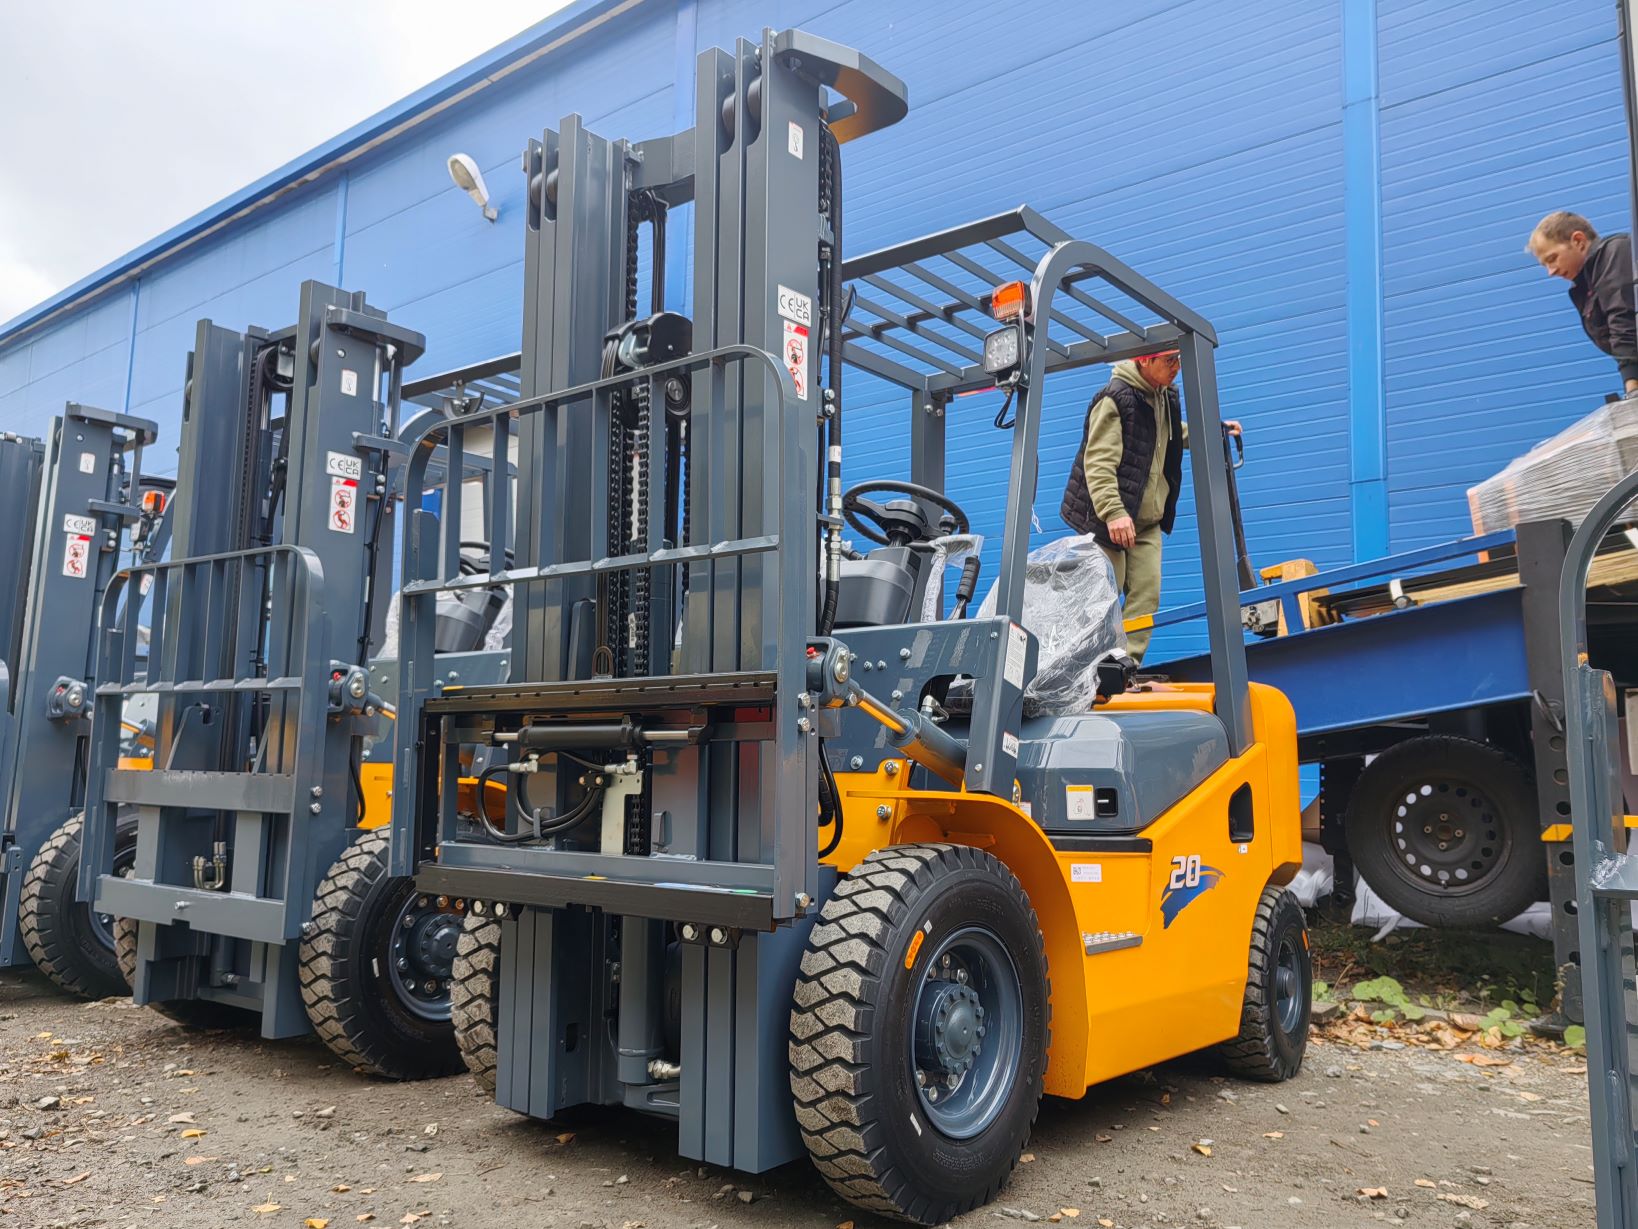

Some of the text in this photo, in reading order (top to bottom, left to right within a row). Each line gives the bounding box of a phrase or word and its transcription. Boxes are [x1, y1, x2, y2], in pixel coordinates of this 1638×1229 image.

[795, 297, 809, 311] UK
[795, 308, 809, 322] CA
[345, 460, 359, 469] UK
[345, 467, 359, 476] CA
[1169, 854, 1201, 890] 20
